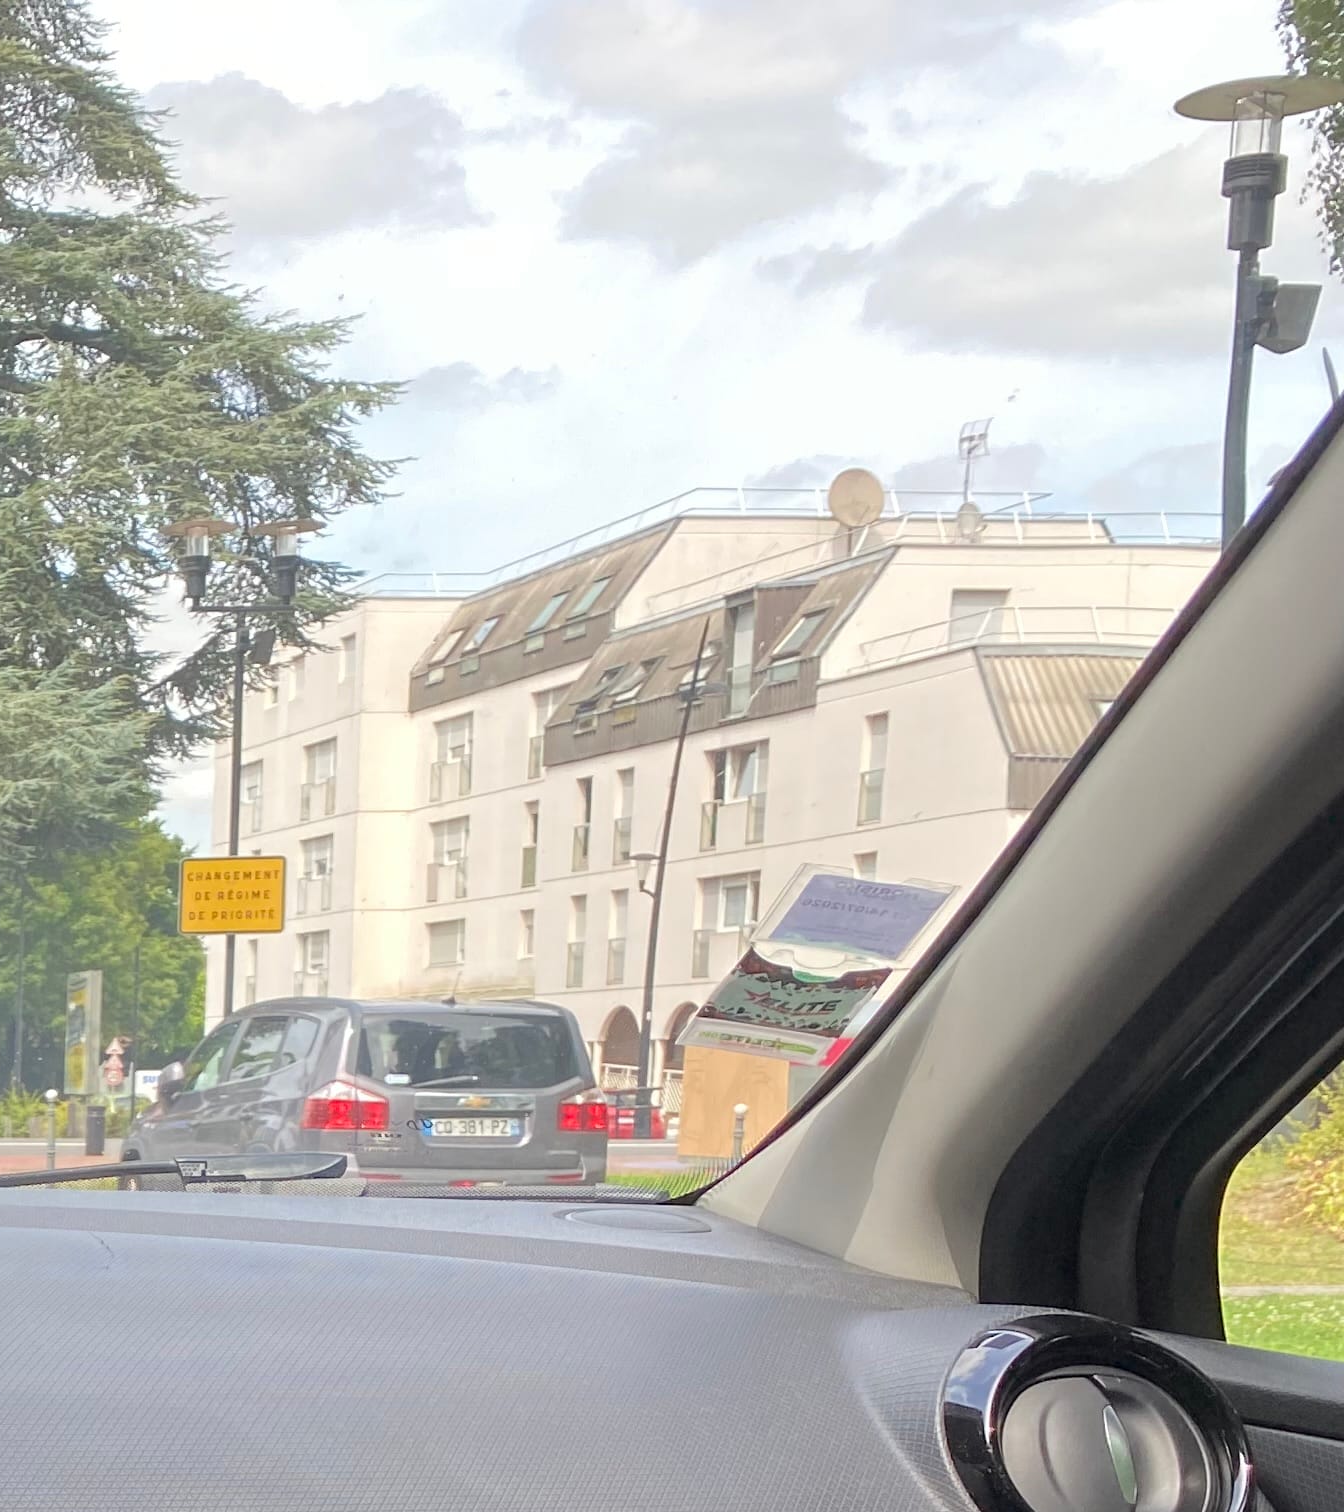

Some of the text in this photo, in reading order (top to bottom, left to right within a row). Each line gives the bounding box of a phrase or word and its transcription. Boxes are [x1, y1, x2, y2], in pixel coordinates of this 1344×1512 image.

[186, 869, 281, 882] CHANGEMENT
[194, 888, 271, 901] DE RÉGIME
[188, 907, 275, 920] DE PRIORITÉ
